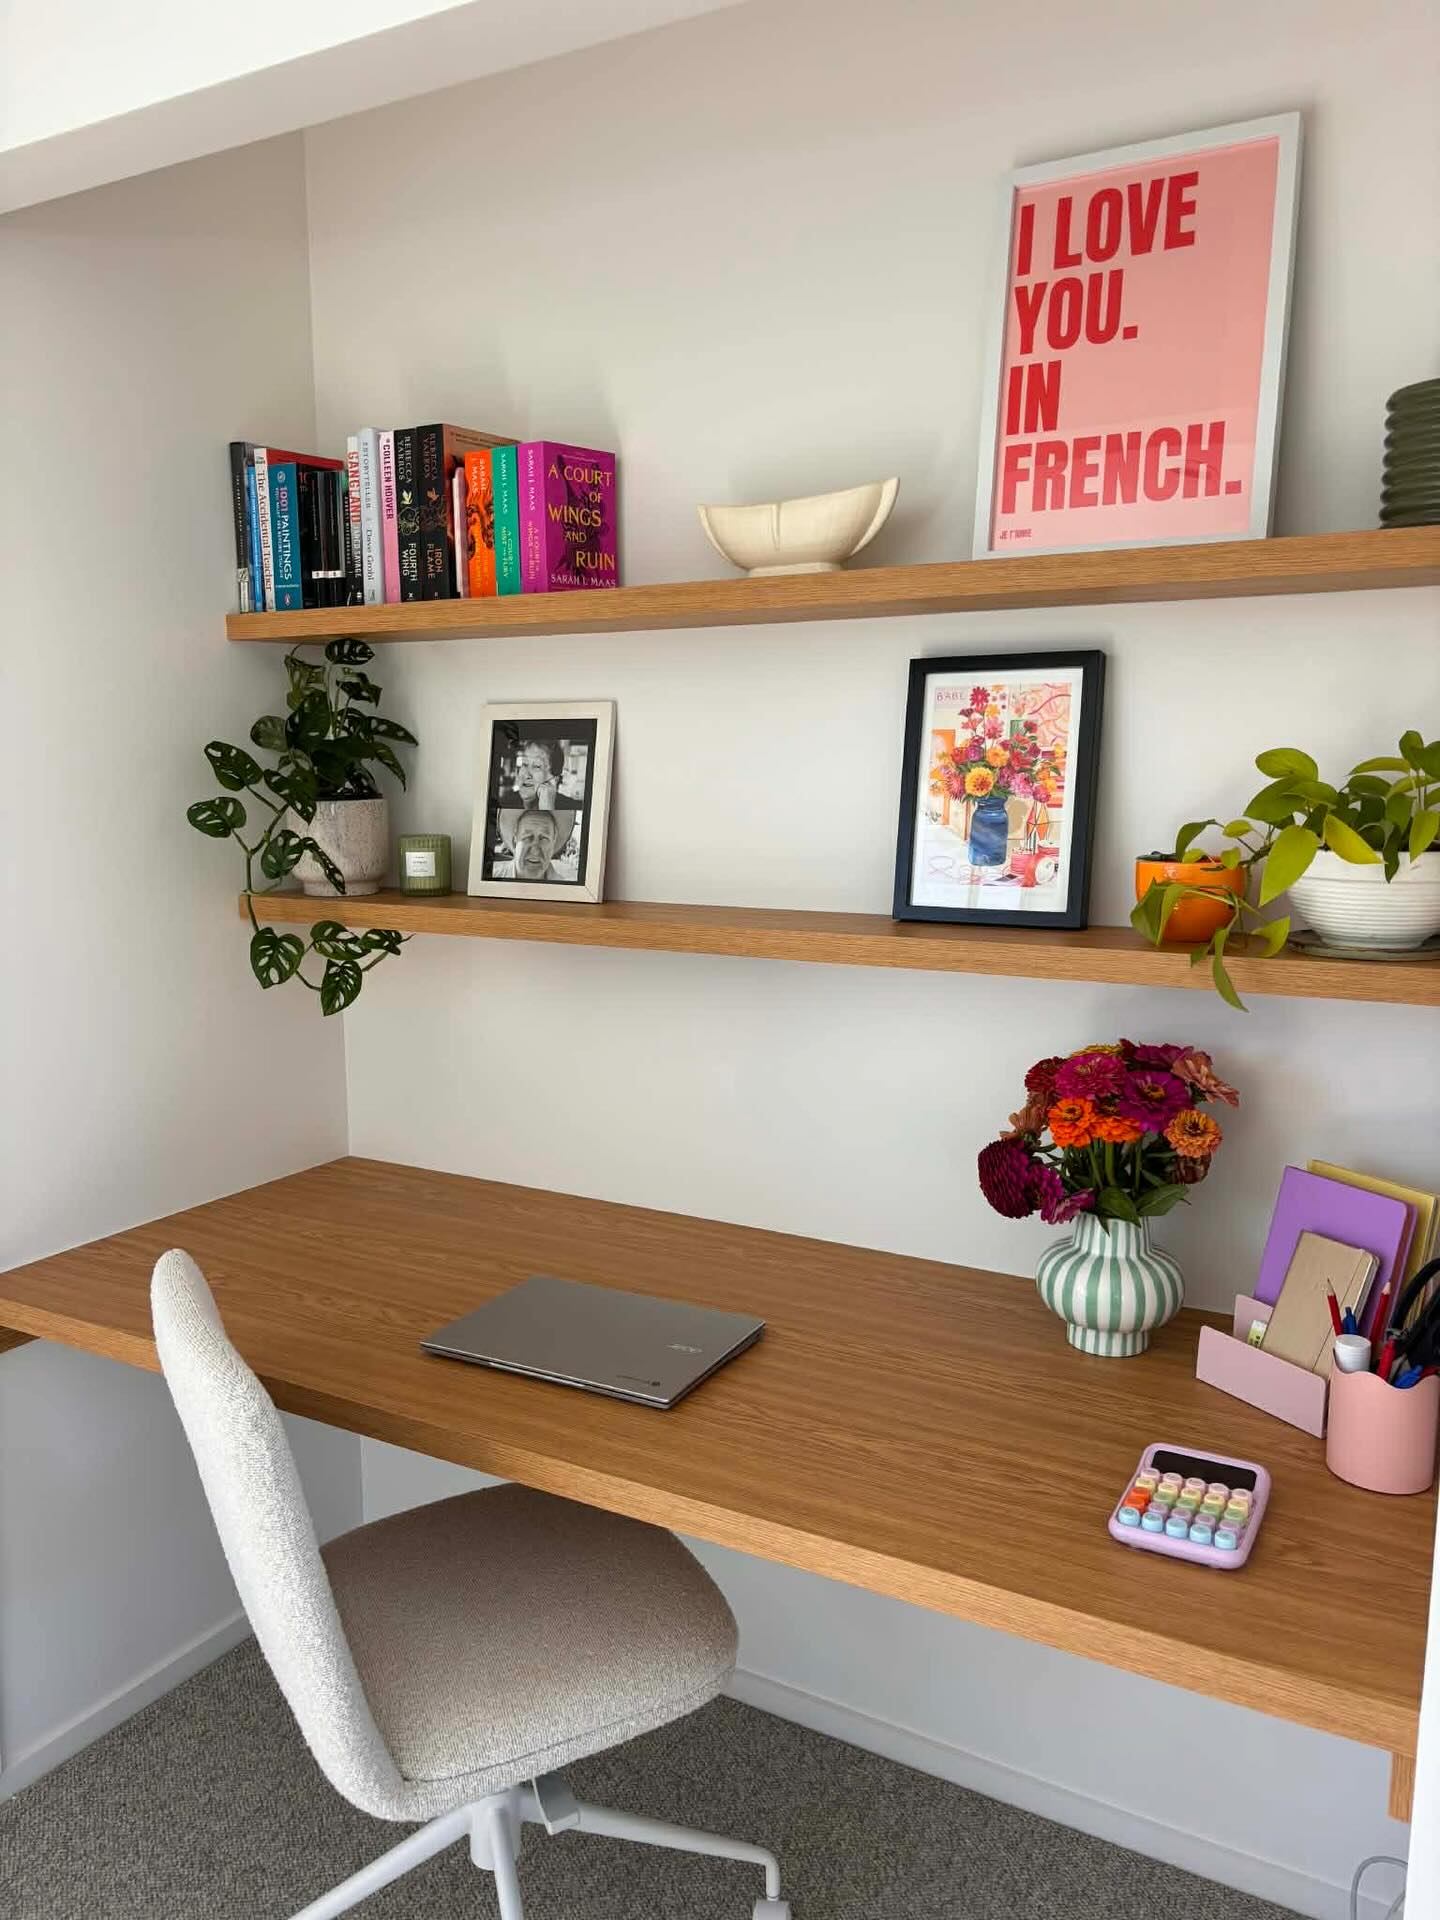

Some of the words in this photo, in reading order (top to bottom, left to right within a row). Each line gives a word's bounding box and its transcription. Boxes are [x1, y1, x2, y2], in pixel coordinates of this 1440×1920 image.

[1016, 203, 1036, 277] I
[1053, 171, 1199, 270] LOVE
[1014, 269, 1139, 355] YOU.
[1006, 359, 1062, 436] IN
[383, 444, 392, 483] COLLEEN
[397, 440, 405, 480] YARROS
[403, 436, 412, 483] REBECCA
[423, 437, 431, 479] YARROS
[429, 433, 437, 480] REBECCA
[527, 449, 535, 477] SARAH
[1001, 421, 1242, 515] FRENCH.
[257, 470, 266, 491] The
[348, 451, 361, 523] GANGLAND
[362, 447, 371, 509] STORYTELLER
[547, 464, 559, 479] A
[563, 465, 613, 487] COURT
[279, 486, 288, 512] 1001
[384, 485, 394, 519] HOOVER
[548, 503, 602, 527] WINGS
[589, 491, 603, 503] OF
[258, 494, 270, 550] Accidental
[565, 531, 587, 543] AND
[281, 515, 292, 580] PAINTINGS
[353, 550, 362, 578] SAVAGE
[402, 549, 410, 576] WING
[408, 543, 417, 581] FOURTH
[427, 544, 436, 578] FLAME
[434, 547, 442, 573] IRON
[575, 550, 615, 571] RUIN
[263, 551, 272, 591] Teacher
[366, 555, 374, 581] Grohl
[550, 573, 580, 585] SARAH
[591, 575, 616, 589] MAAS
